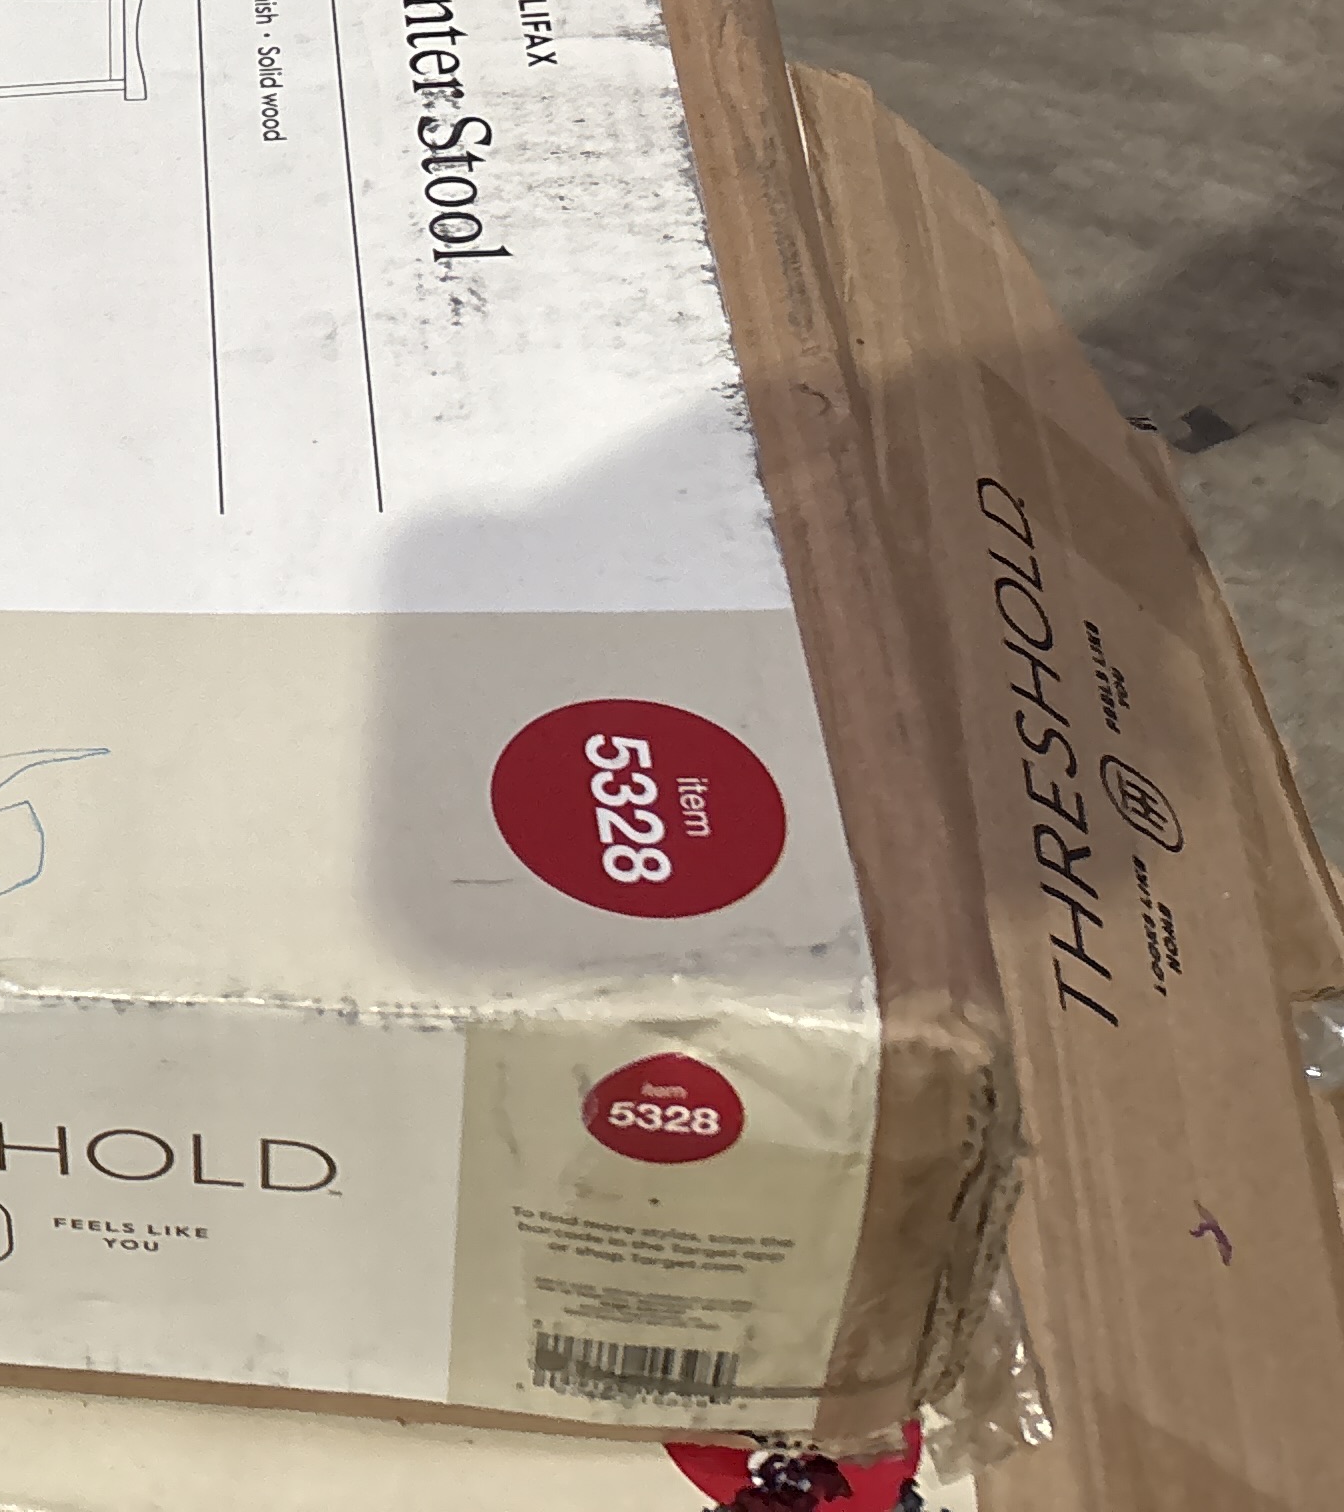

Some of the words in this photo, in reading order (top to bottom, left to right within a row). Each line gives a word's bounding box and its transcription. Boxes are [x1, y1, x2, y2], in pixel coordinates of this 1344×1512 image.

[256, 46, 284, 87] Solid
[260, 93, 287, 142] wood
[415, 115, 513, 264] Stool
[975, 477, 1119, 1026] THRESHOLD
[583, 734, 671, 883] 5328
[675, 777, 711, 837] item
[607, 1100, 722, 1138] 5328
[52, 1216, 137, 1238] FEELS
[148, 1222, 210, 1241] LIKE
[102, 1236, 161, 1254] YOU
